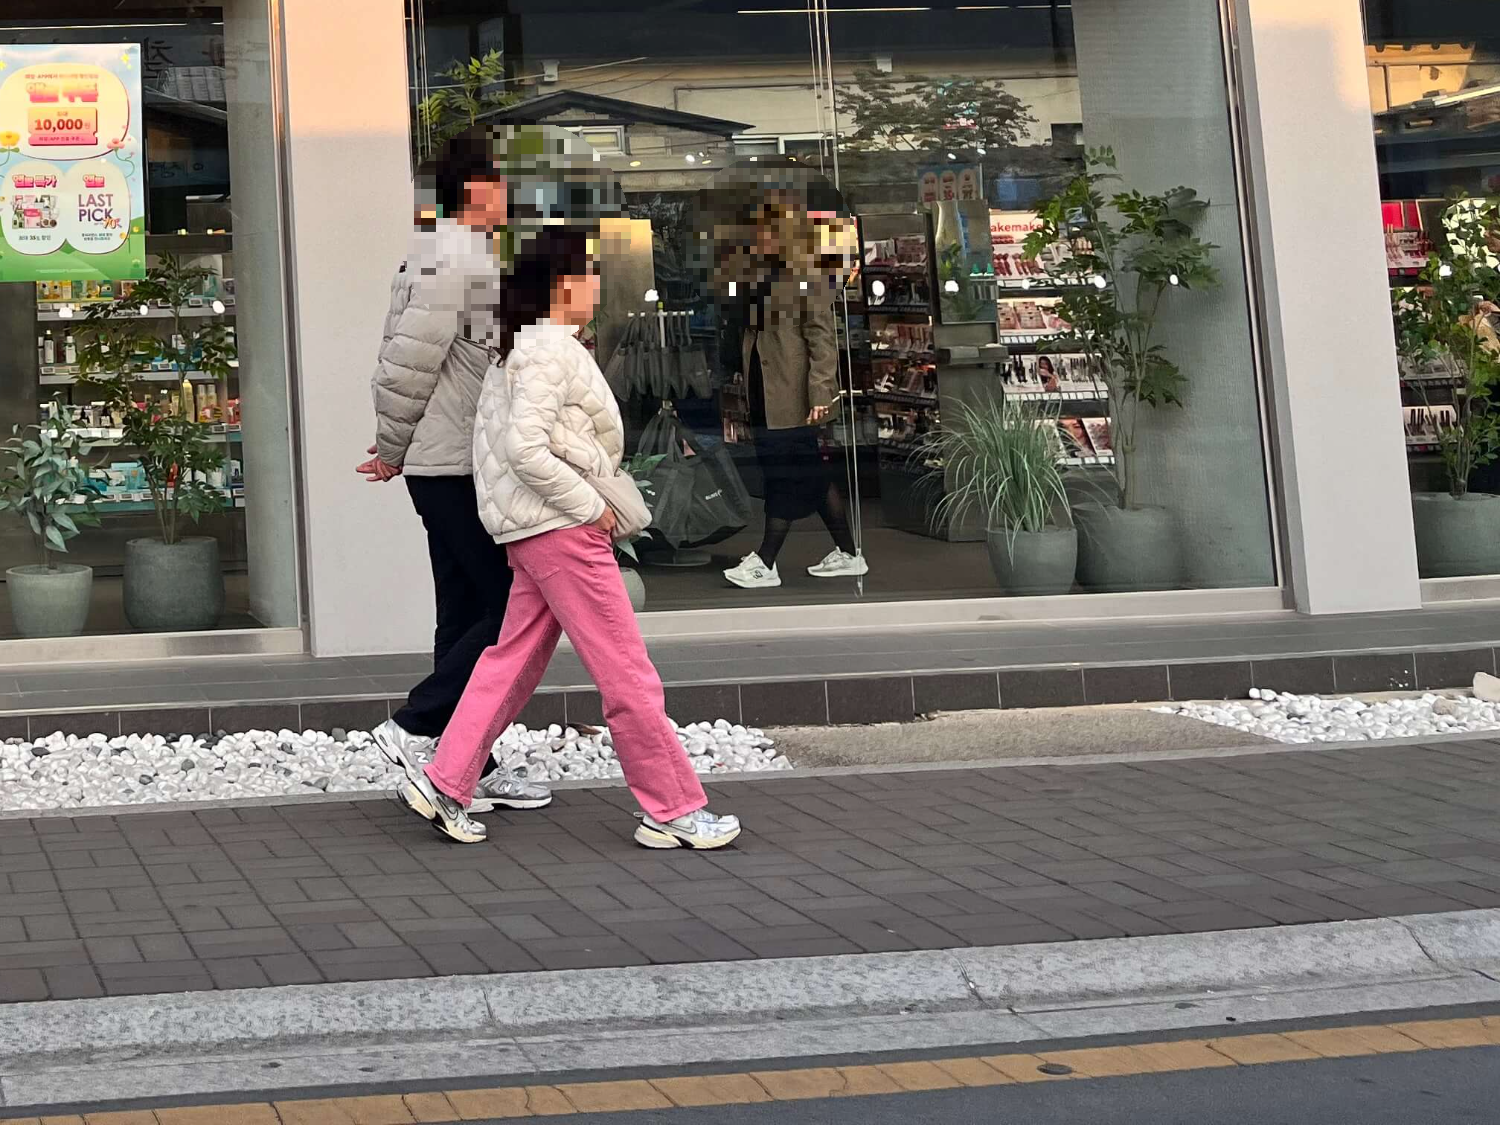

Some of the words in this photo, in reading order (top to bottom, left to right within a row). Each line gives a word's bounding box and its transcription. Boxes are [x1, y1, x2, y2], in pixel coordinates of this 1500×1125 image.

[78, 194, 114, 207] LAST
[78, 208, 114, 222] PICK
[990, 220, 1043, 233] akemake
